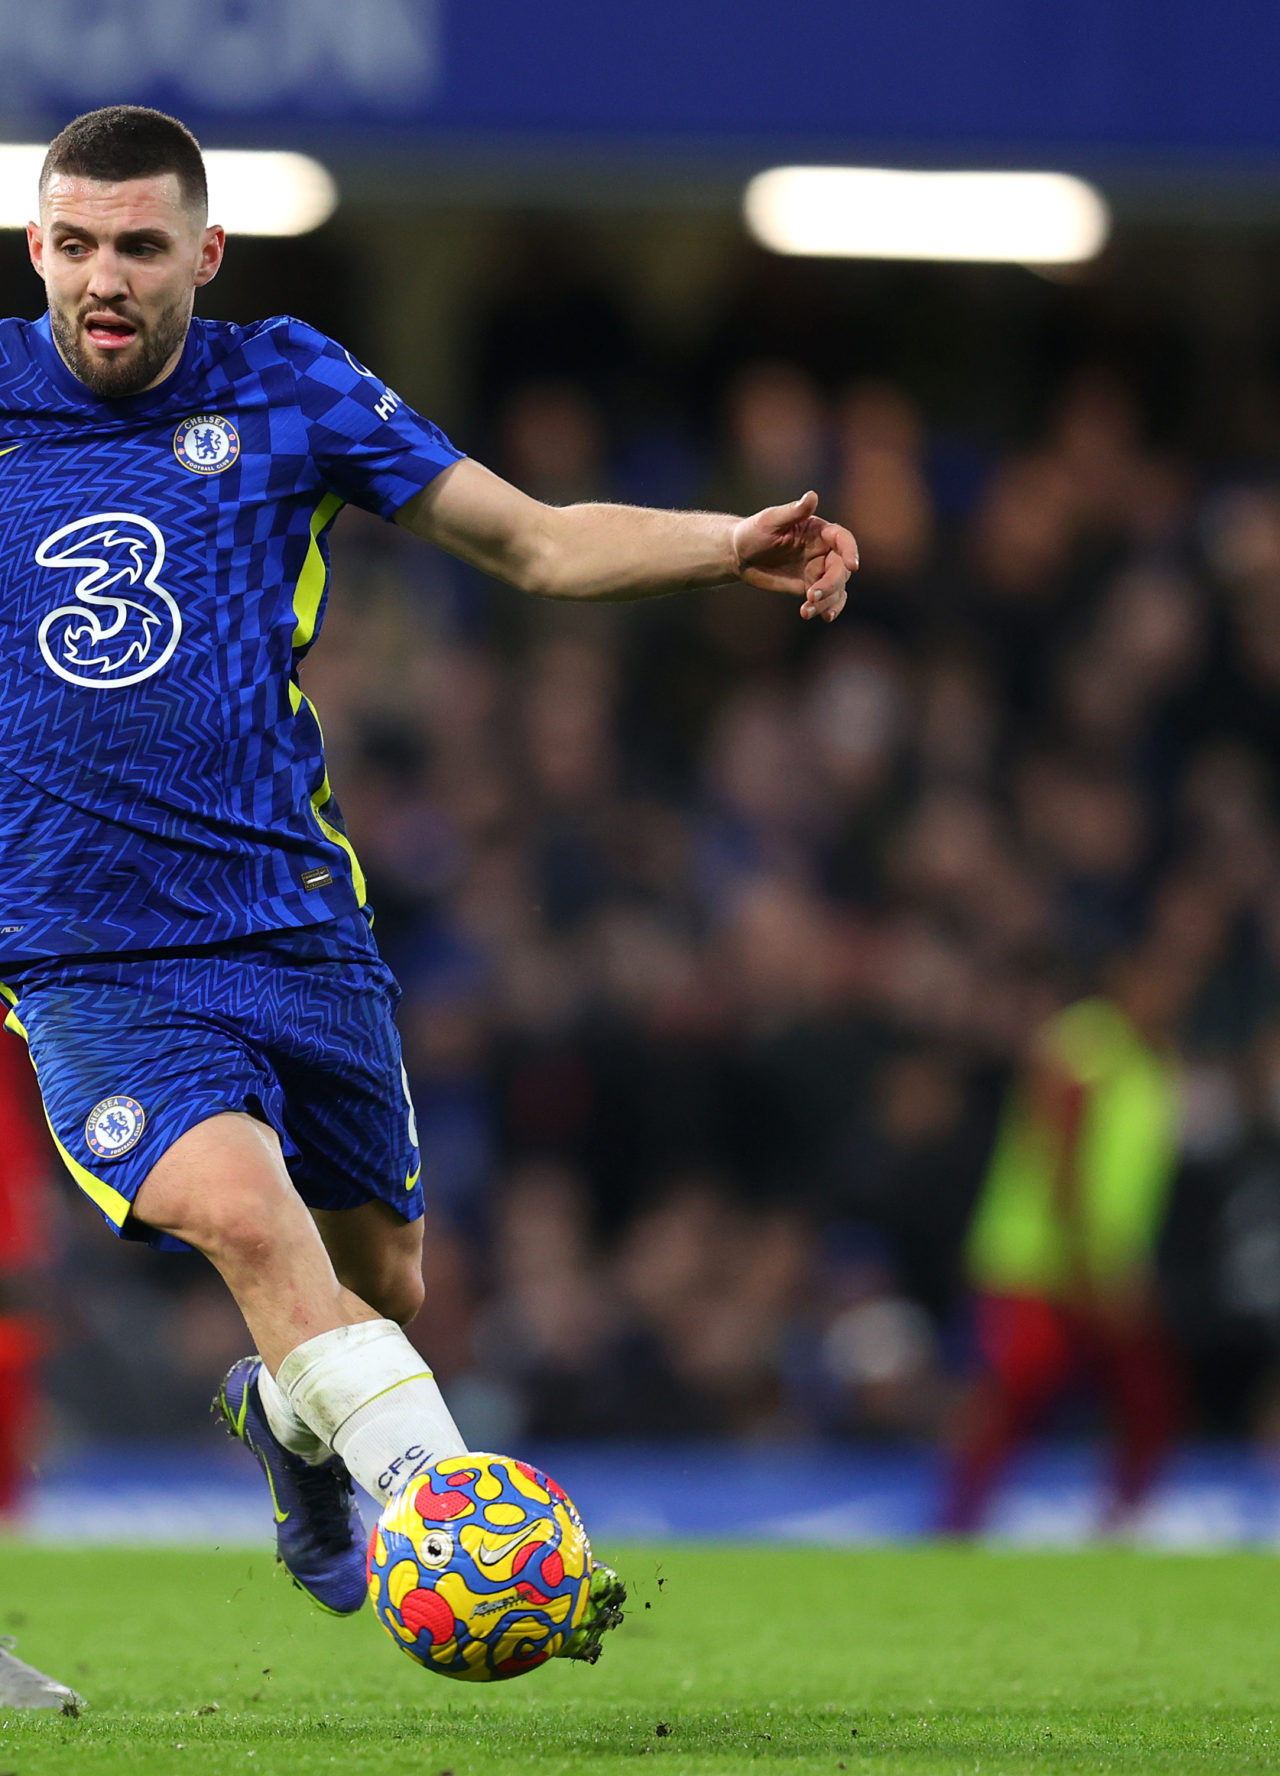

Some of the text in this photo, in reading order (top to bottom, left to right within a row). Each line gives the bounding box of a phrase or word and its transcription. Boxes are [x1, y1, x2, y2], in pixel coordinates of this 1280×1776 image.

[373, 386, 402, 421] HY
[184, 415, 226, 430] CHELSEA
[186, 459, 230, 471] FOOTBALL CLUB
[35, 512, 182, 689] 3
[88, 1098, 119, 1131] CHELSEA
[110, 1138, 135, 1155] FOOTBALL
[378, 1444, 425, 1490] CFC
